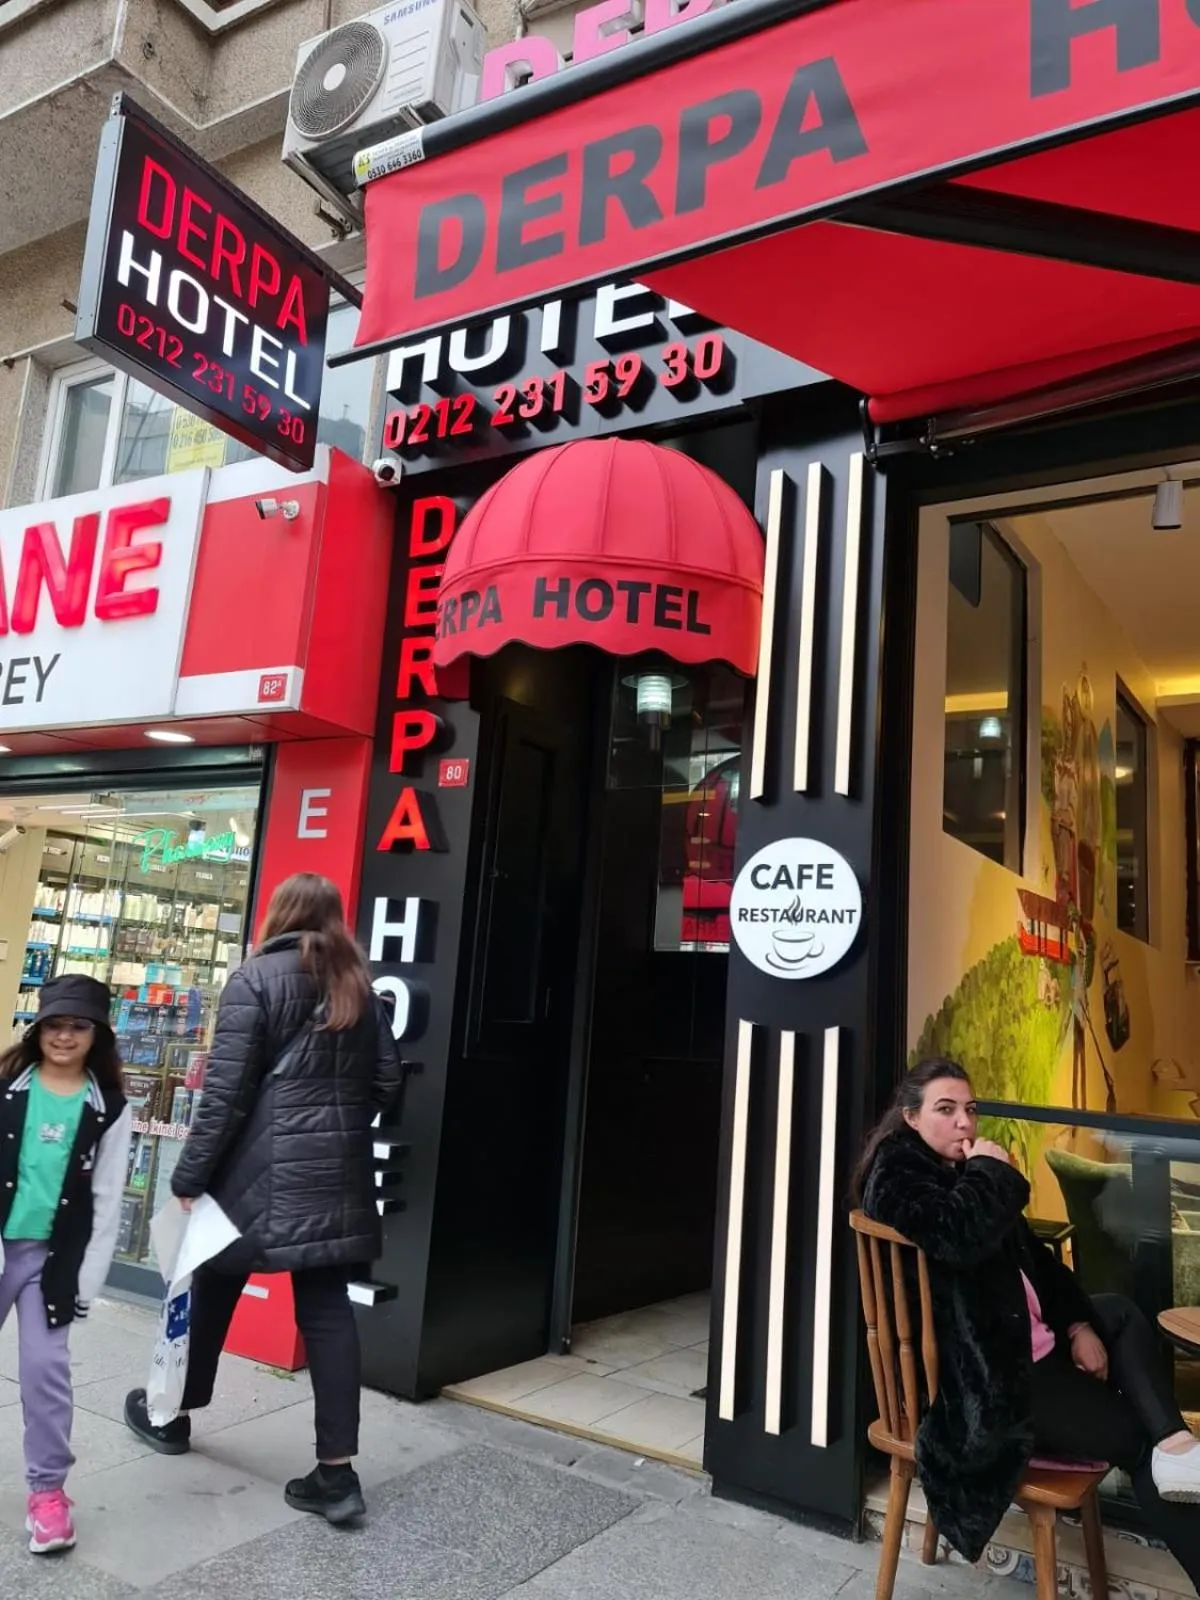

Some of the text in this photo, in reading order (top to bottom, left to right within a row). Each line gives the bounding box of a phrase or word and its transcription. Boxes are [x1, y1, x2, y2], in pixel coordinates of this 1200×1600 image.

[414, 0, 1200, 300] DERPA H
[137, 154, 308, 348] DERPA
[117, 229, 311, 411] HOTEL
[117, 303, 183, 369] 0212
[192, 351, 236, 401] 231
[241, 384, 272, 422] 59
[277, 407, 305, 444] 30
[384, 332, 725, 449] 0212 231 59 30
[0, 496, 171, 636] NE
[532, 576, 712, 635] HOTEL
[446, 765, 461, 780] 80
[738, 907, 858, 925] RESTAURANT
[750, 863, 835, 890] CAFE
